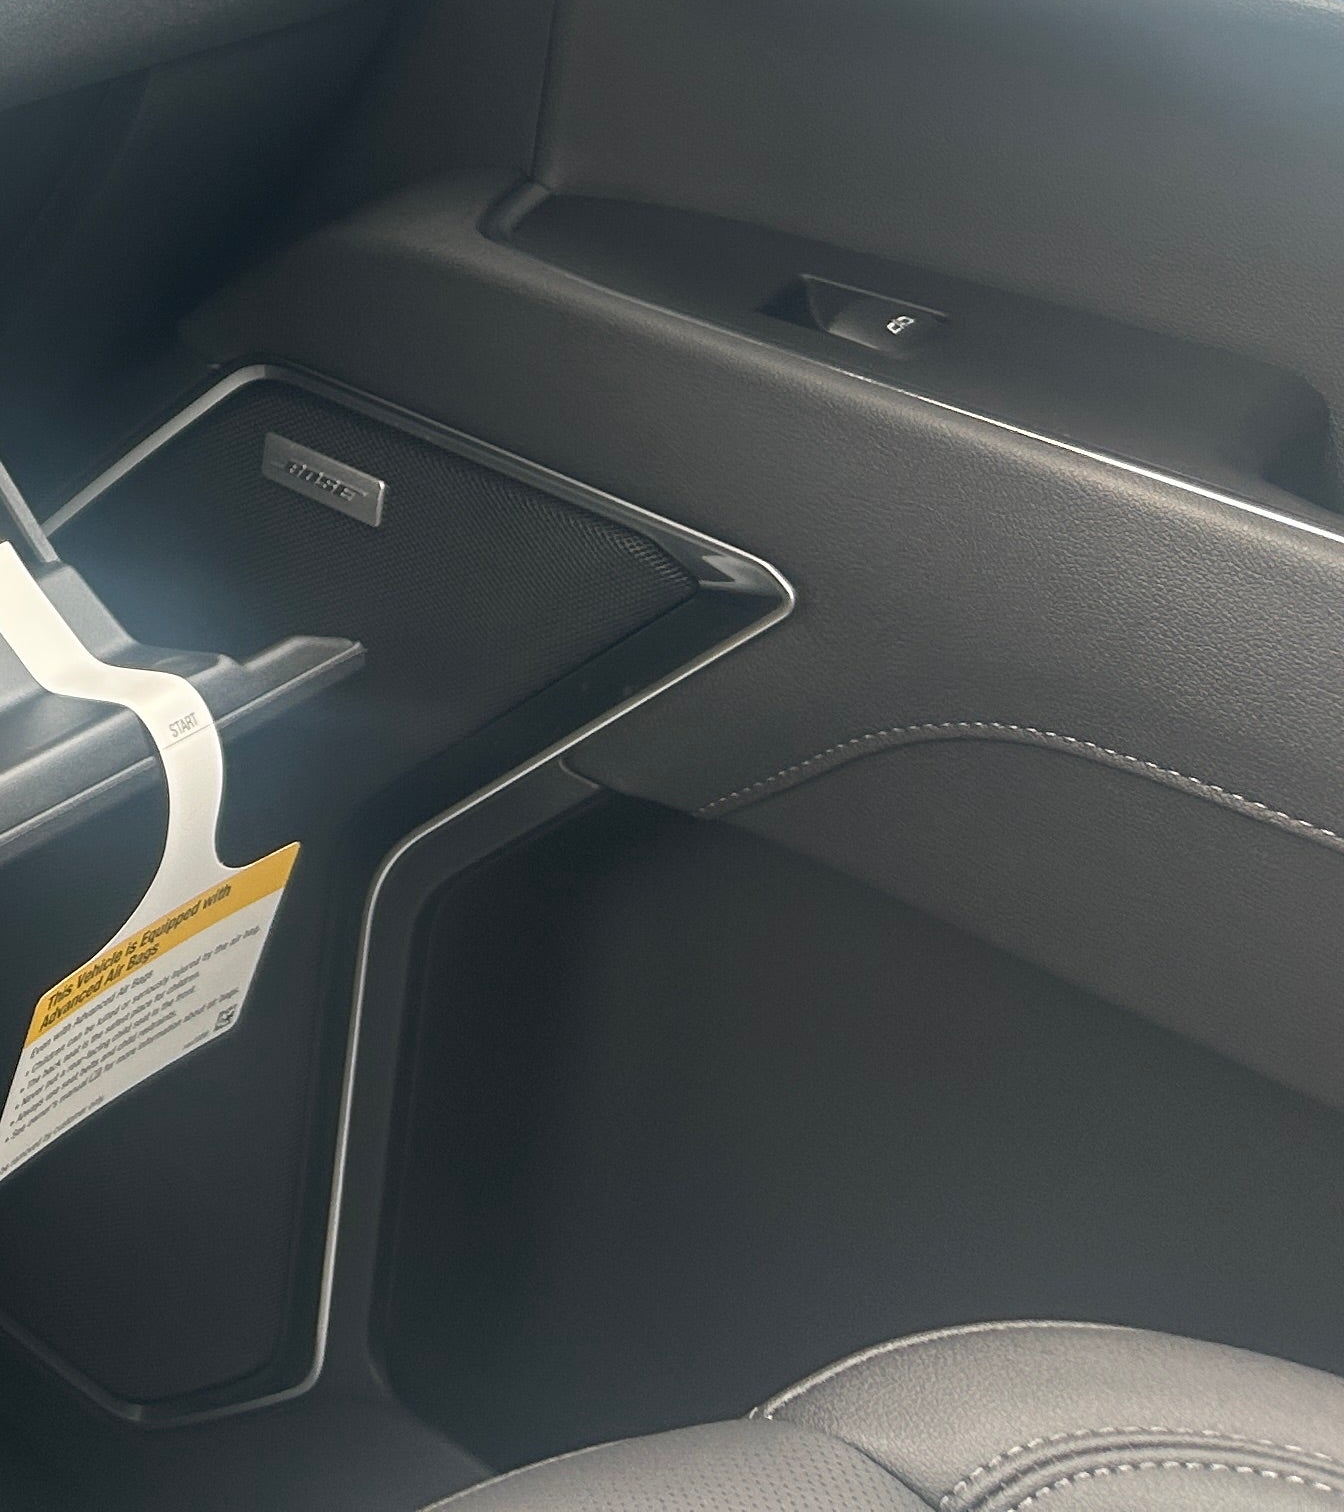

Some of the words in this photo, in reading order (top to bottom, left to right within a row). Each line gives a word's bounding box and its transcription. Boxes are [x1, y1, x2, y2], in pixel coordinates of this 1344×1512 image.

[168, 711, 200, 738] START
[40, 976, 103, 1030] Advanced
[103, 964, 125, 986] Air
[126, 943, 159, 971] Bags
[48, 984, 73, 1010] This
[77, 951, 123, 988] Vehicle
[124, 941, 138, 957] is
[140, 901, 201, 947] Equipped
[202, 884, 232, 909] with
